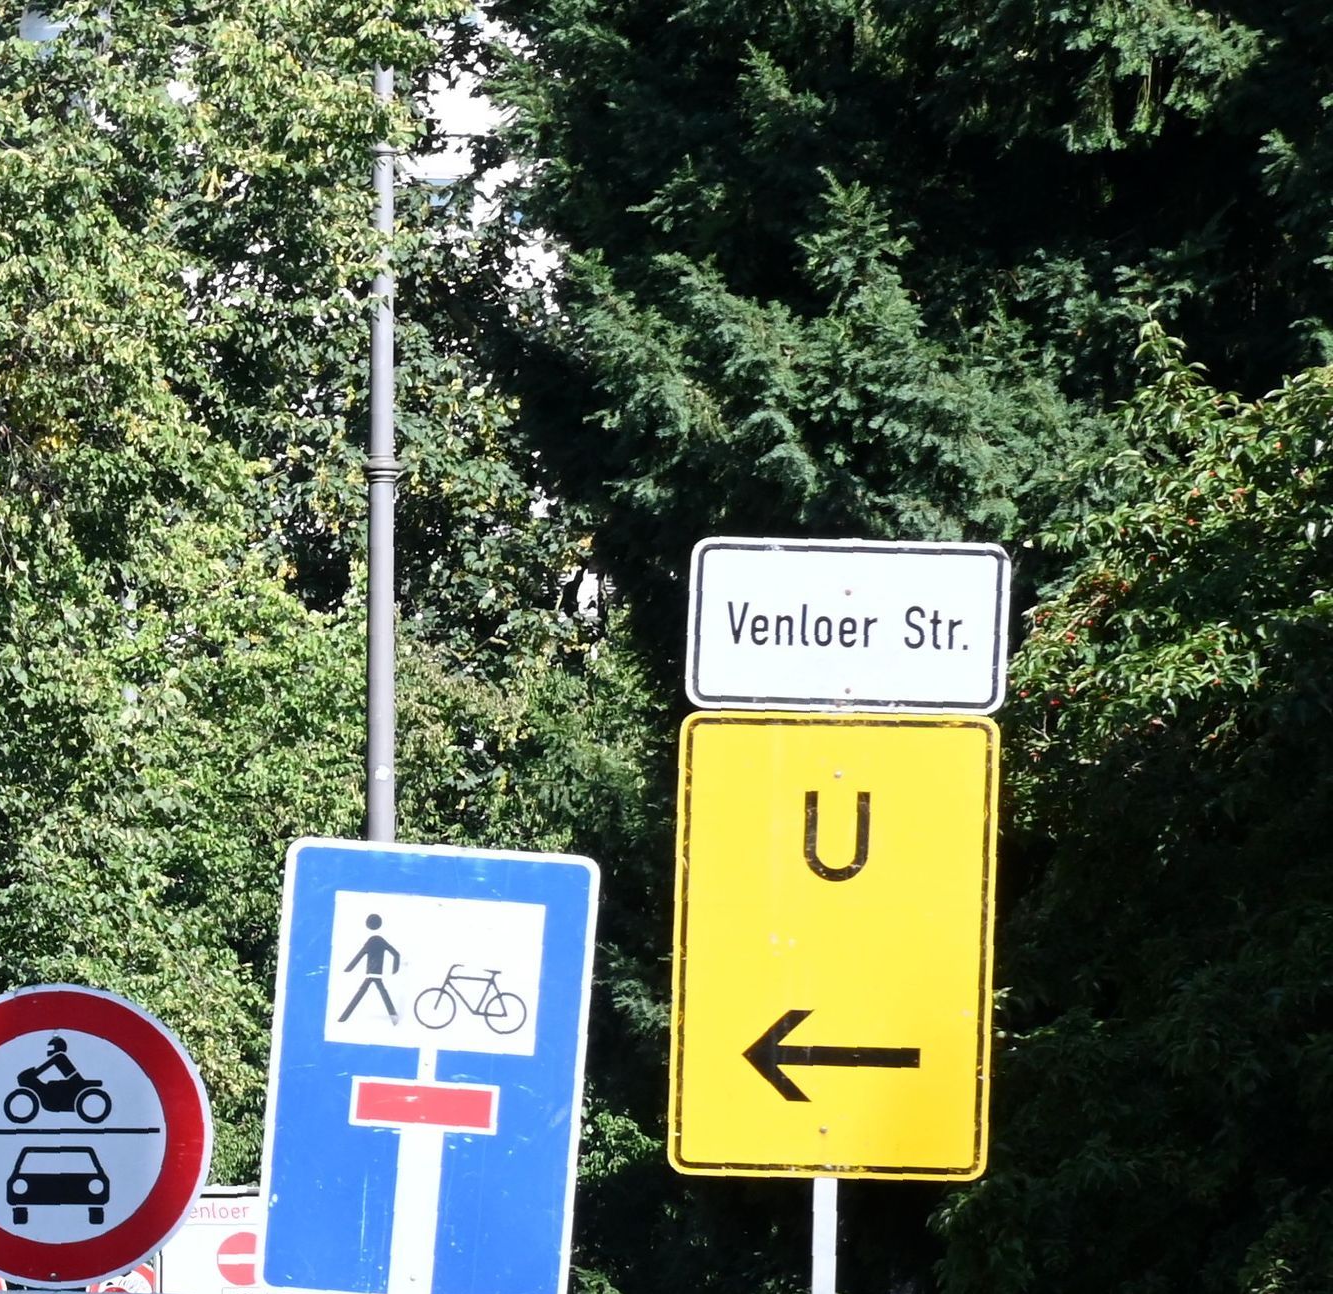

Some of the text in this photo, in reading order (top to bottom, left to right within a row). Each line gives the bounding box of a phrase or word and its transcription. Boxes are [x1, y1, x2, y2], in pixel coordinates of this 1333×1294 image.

[727, 600, 969, 651] Venloer Str.
[803, 790, 871, 882] U
[189, 1203, 250, 1219] enloer
